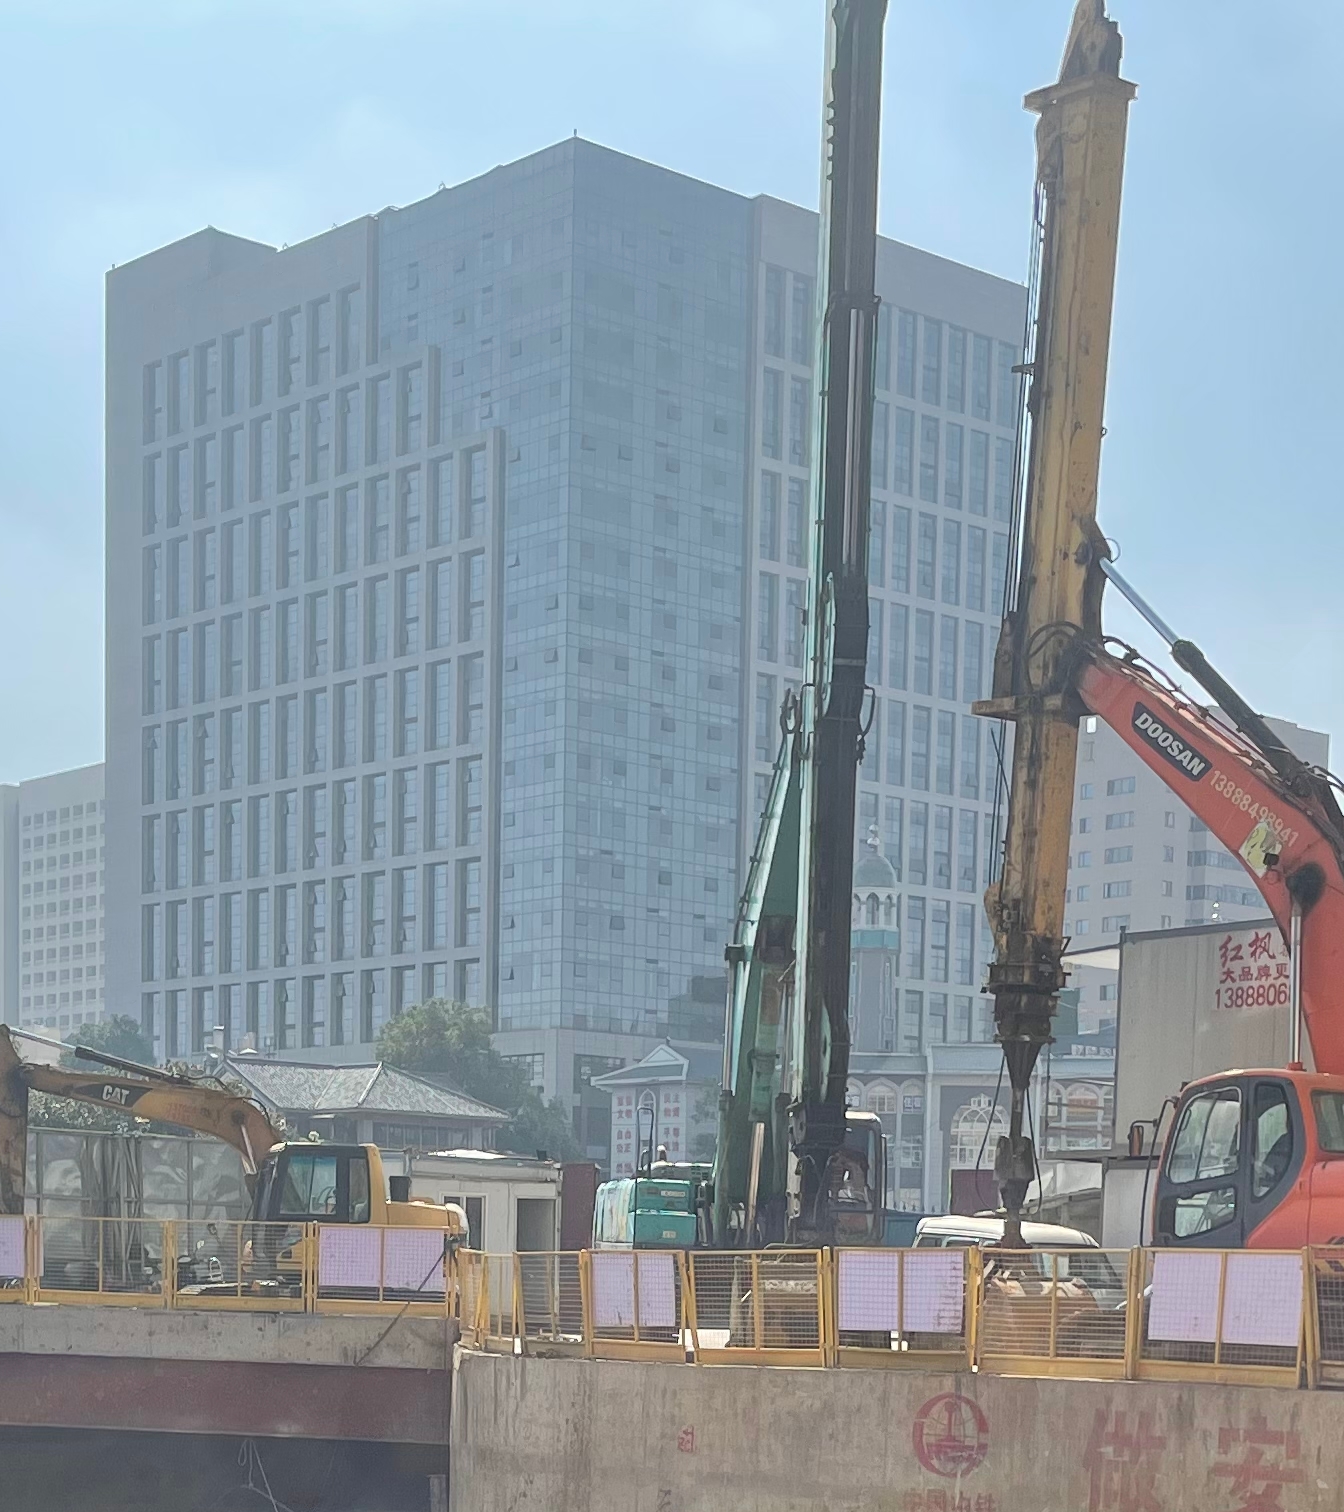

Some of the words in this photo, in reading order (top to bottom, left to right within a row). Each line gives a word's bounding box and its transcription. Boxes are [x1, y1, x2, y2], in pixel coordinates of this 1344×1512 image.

[1134, 712, 1206, 777] DOOSAN
[1210, 770, 1299, 848] 13888498941
[1215, 982, 1291, 1009] 1388806
[102, 1084, 130, 1105] CAT
